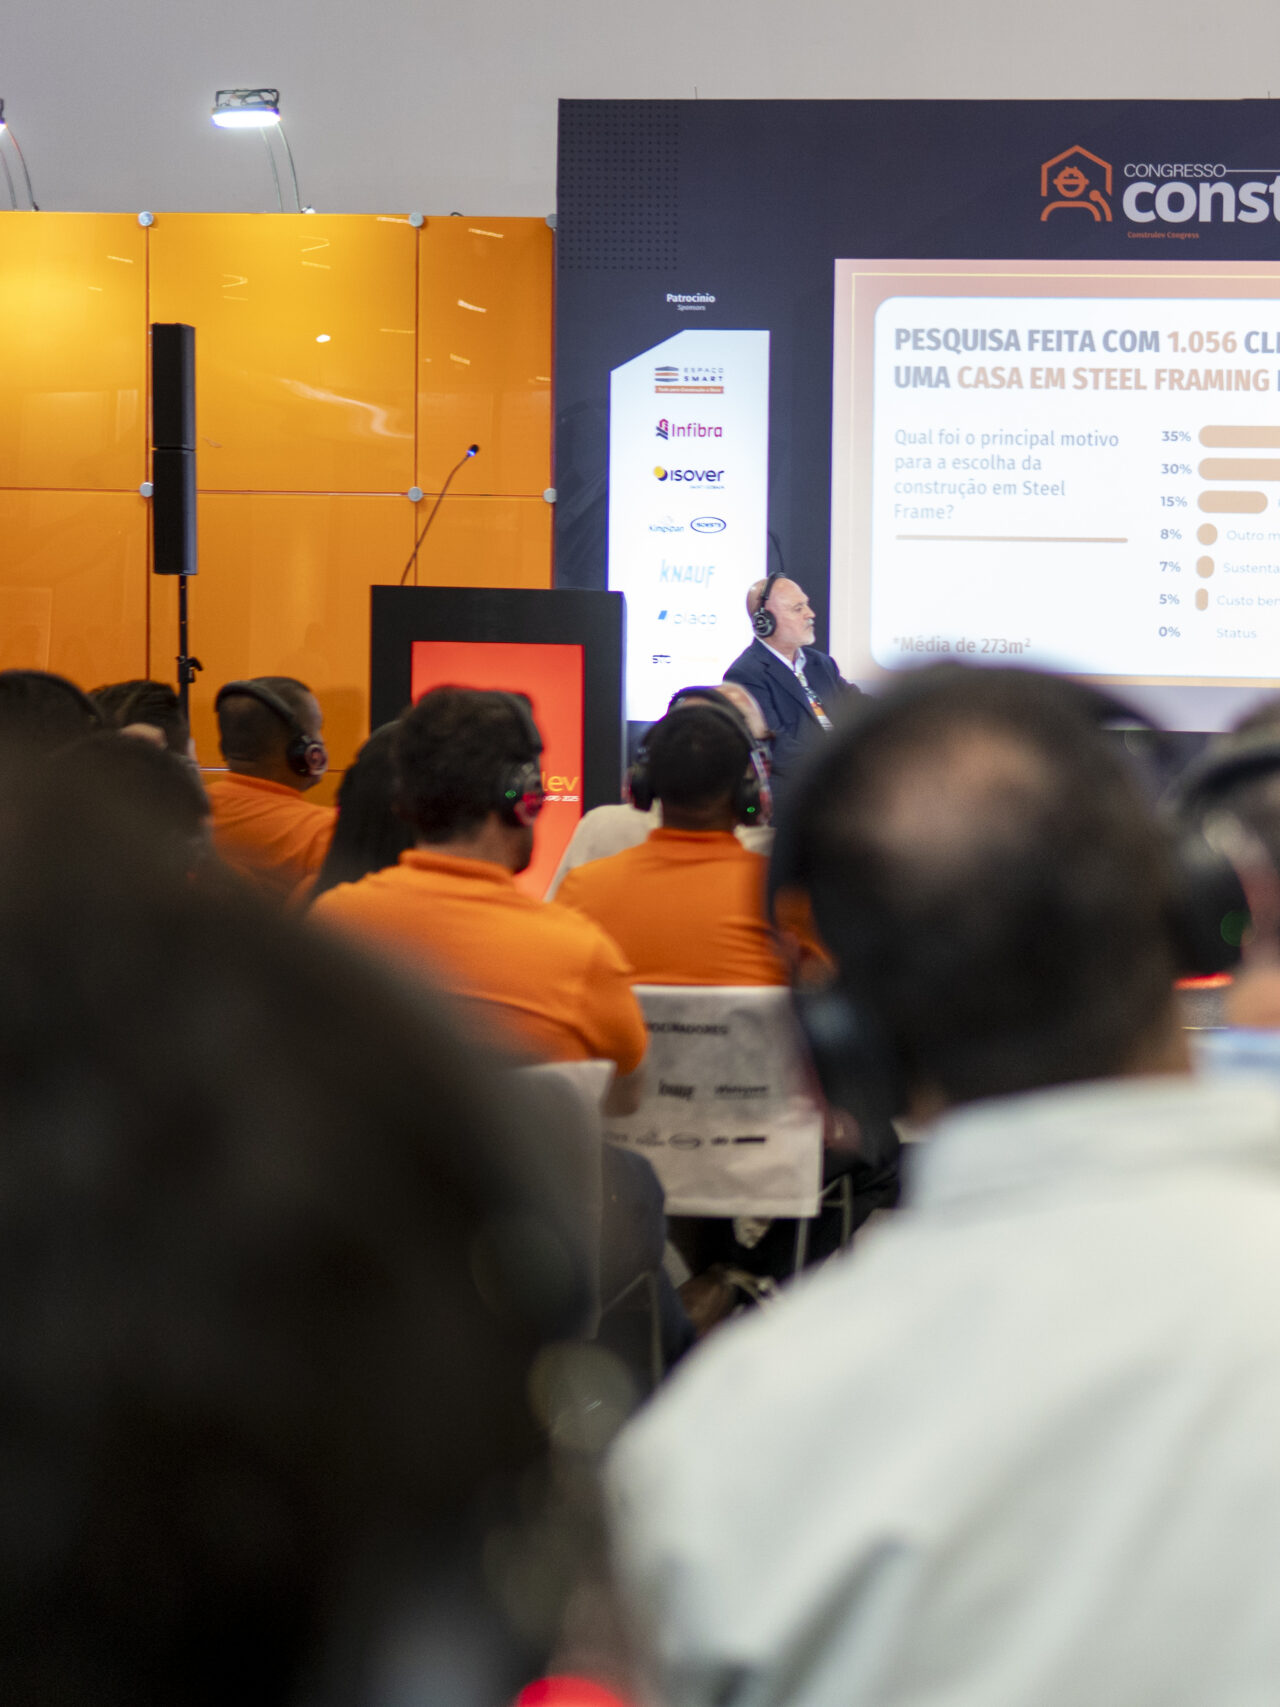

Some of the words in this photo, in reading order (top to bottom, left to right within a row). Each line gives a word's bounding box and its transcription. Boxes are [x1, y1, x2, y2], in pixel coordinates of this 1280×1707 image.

[1123, 163, 1227, 178] CONGRESSO
[894, 328, 1021, 354] PESQUISA
[1027, 329, 1095, 352] FEITA
[1102, 330, 1160, 352] COM
[1167, 331, 1238, 353] 1.056
[894, 366, 951, 388] UMA
[957, 366, 1023, 389] CASA
[1029, 367, 1066, 389] EM
[1073, 367, 1147, 390] STEEL
[1155, 368, 1270, 392] FRAMING
[671, 422, 723, 438] Infibra
[1161, 430, 1192, 443] 35%
[894, 429, 933, 446] Qual
[938, 429, 961, 446] foi
[966, 433, 976, 446] o
[981, 430, 1055, 450] principal
[1060, 431, 1119, 447] motivo
[894, 455, 932, 472] para
[937, 456, 947, 470] a
[952, 454, 1016, 471] escolha
[1021, 455, 1042, 471] da
[1160, 463, 1192, 475] 30%
[894, 478, 987, 499] construção
[992, 483, 1017, 496] em
[1022, 480, 1066, 497] Steel
[1160, 495, 1188, 508] 15%
[894, 504, 954, 520] Frame?
[1160, 528, 1182, 541] 8%
[1226, 529, 1265, 542] Outro
[1160, 561, 1181, 573] 7%
[1159, 593, 1180, 606] 5%
[1216, 594, 1254, 607] Custo
[1158, 626, 1181, 638] 0%
[1216, 627, 1257, 639] Status
[955, 637, 976, 653] de
